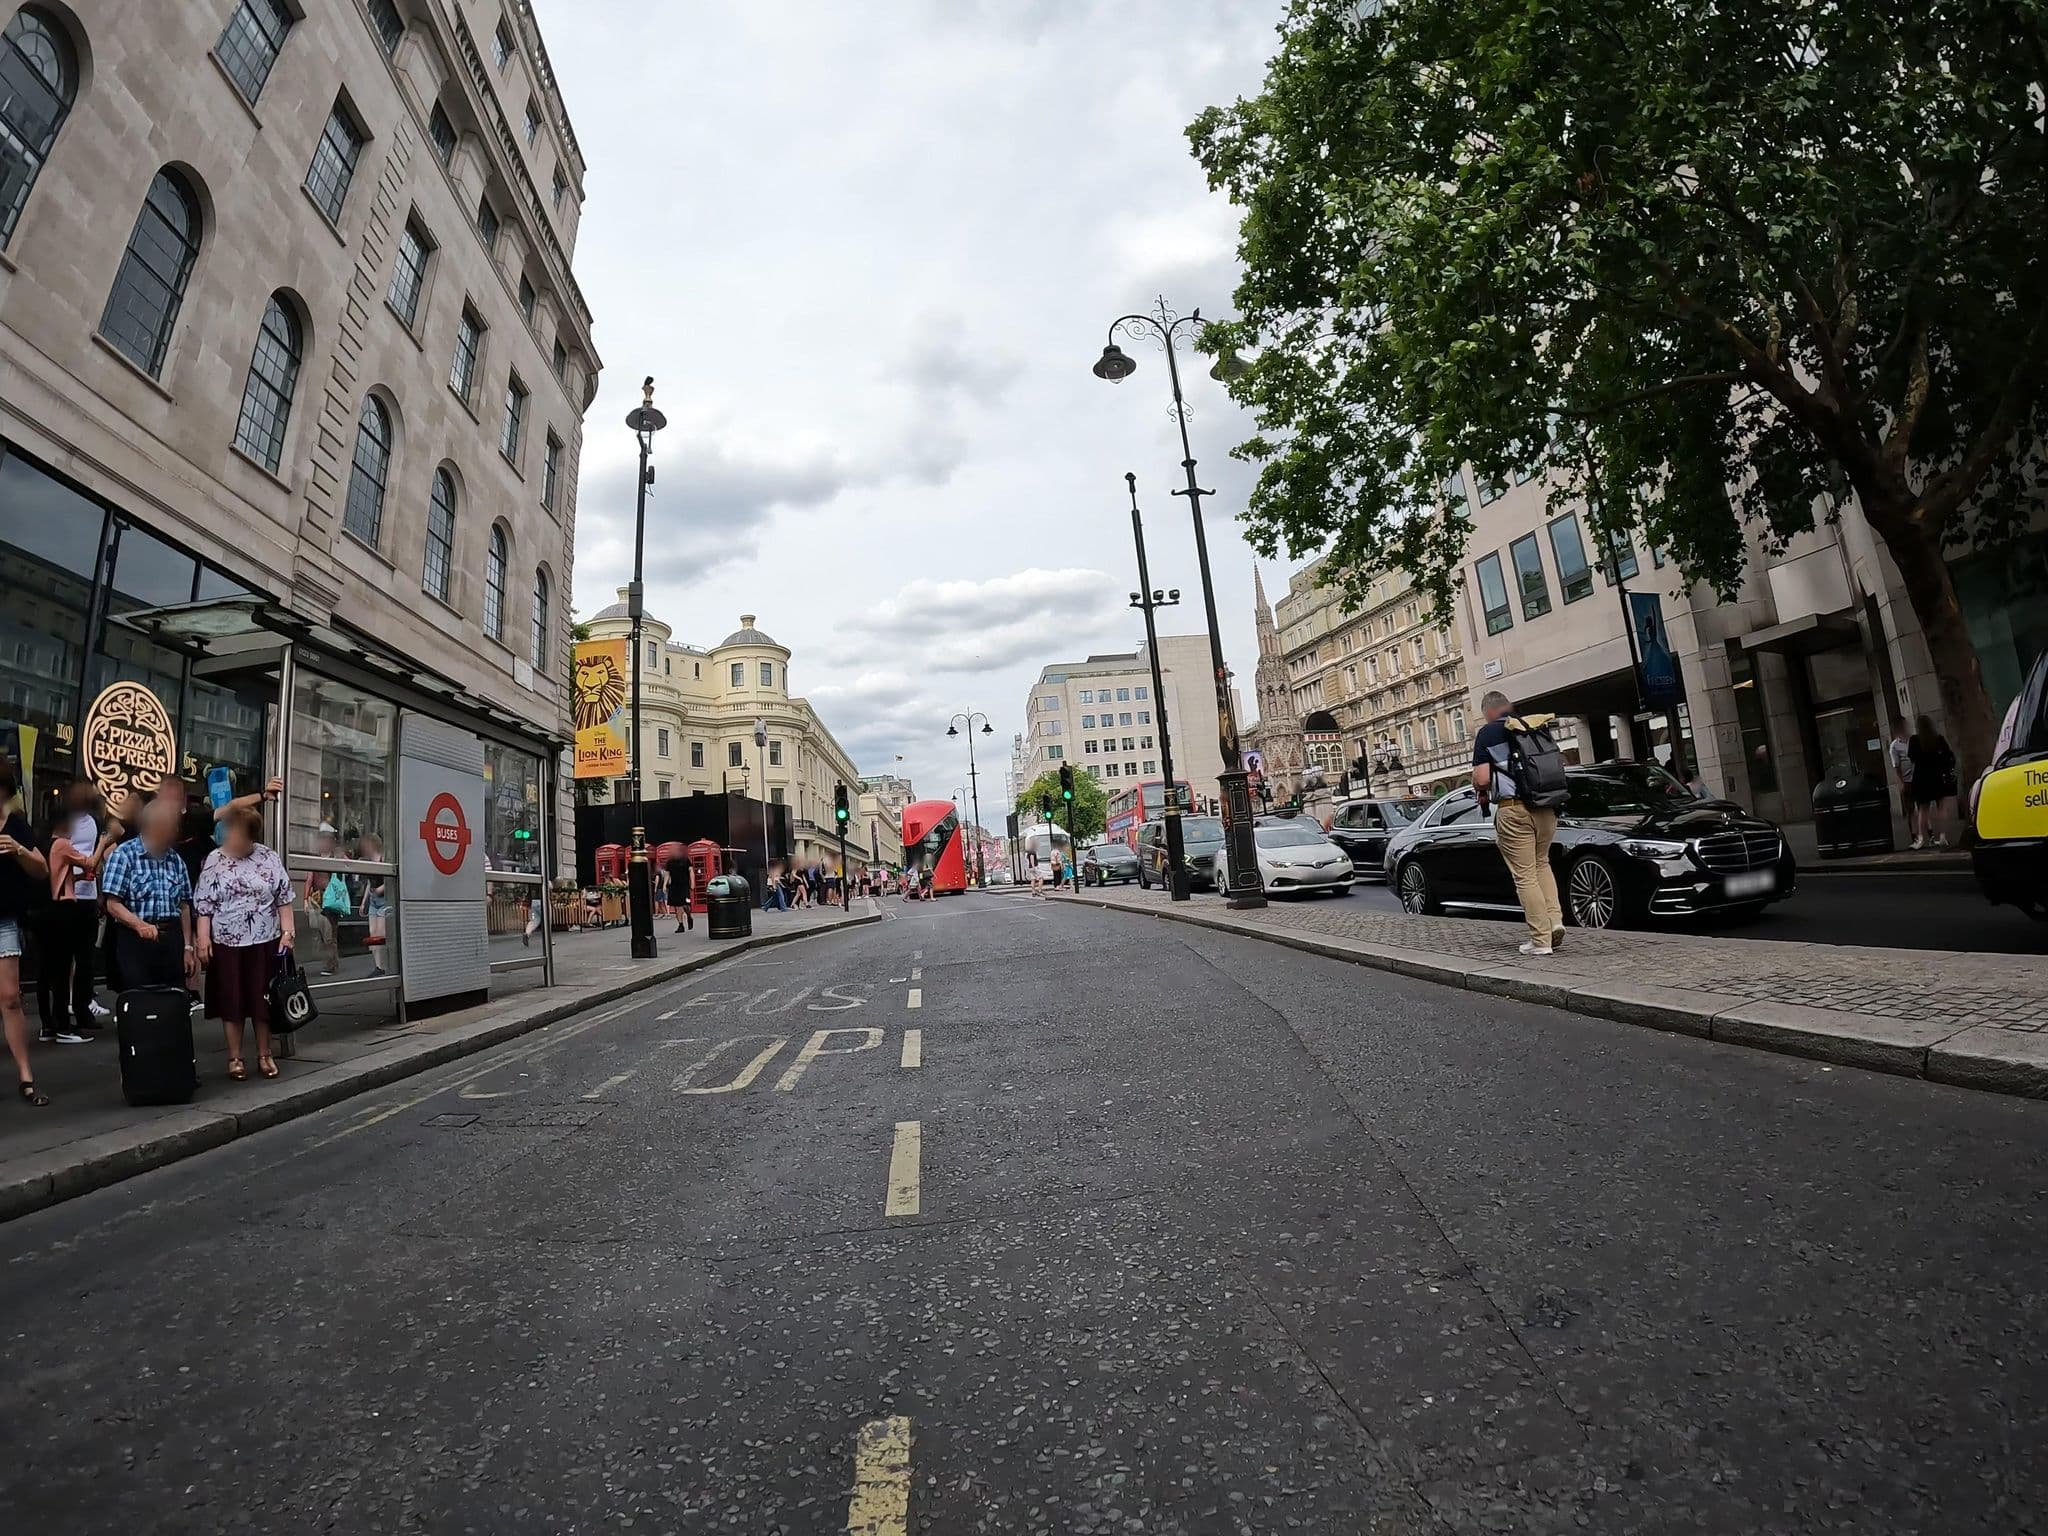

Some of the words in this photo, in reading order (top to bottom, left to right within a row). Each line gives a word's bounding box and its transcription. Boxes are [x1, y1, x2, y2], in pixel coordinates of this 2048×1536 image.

[109, 725, 155, 753] PIZZA
[594, 737, 606, 745] THE
[94, 740, 166, 773] EXPRESS
[436, 827, 458, 840] BUSES
[655, 984, 874, 1020] BUS
